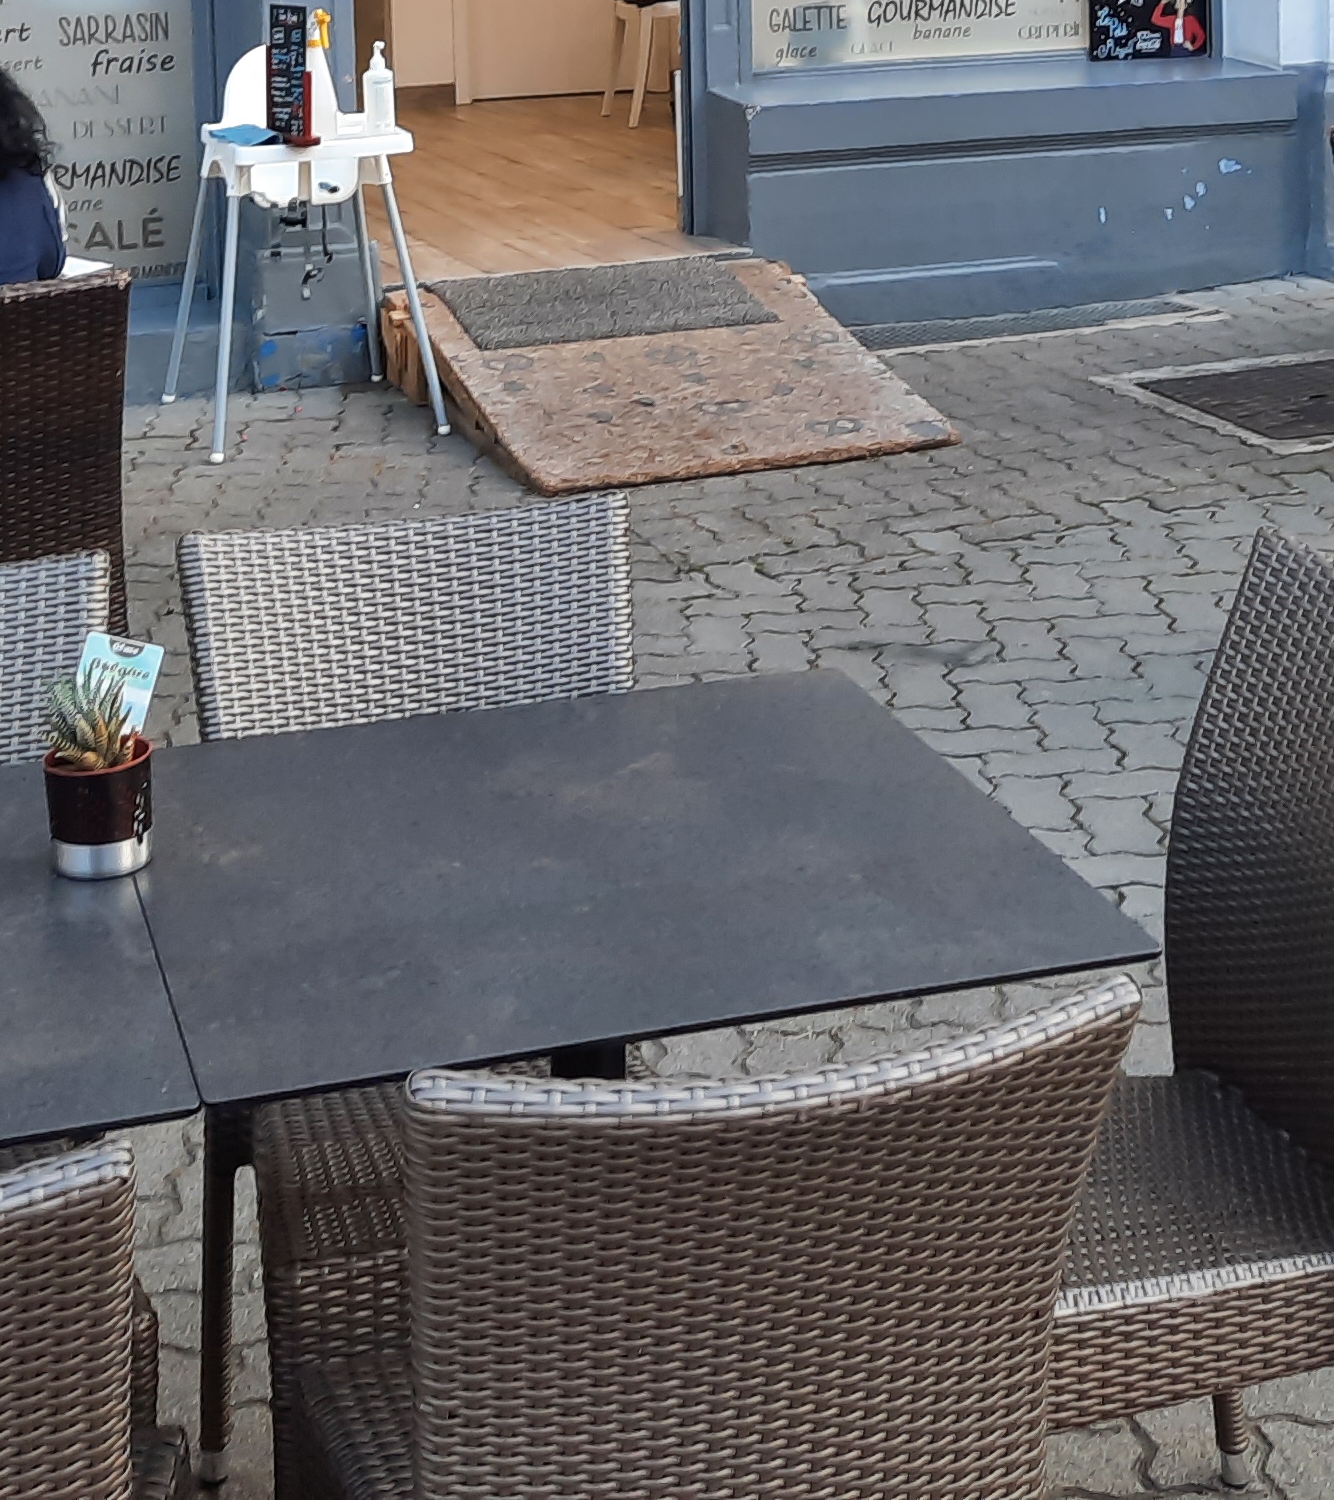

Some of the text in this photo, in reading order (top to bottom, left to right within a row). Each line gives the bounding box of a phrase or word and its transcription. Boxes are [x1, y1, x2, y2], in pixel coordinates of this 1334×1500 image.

[58, 10, 171, 48] SARRASIN
[769, 2, 848, 34] GALETTE
[913, 23, 973, 41] banane
[90, 49, 176, 77] fraise
[775, 41, 818, 66] glace
[52, 154, 182, 191] RMANDISE
[67, 198, 104, 213] ane
